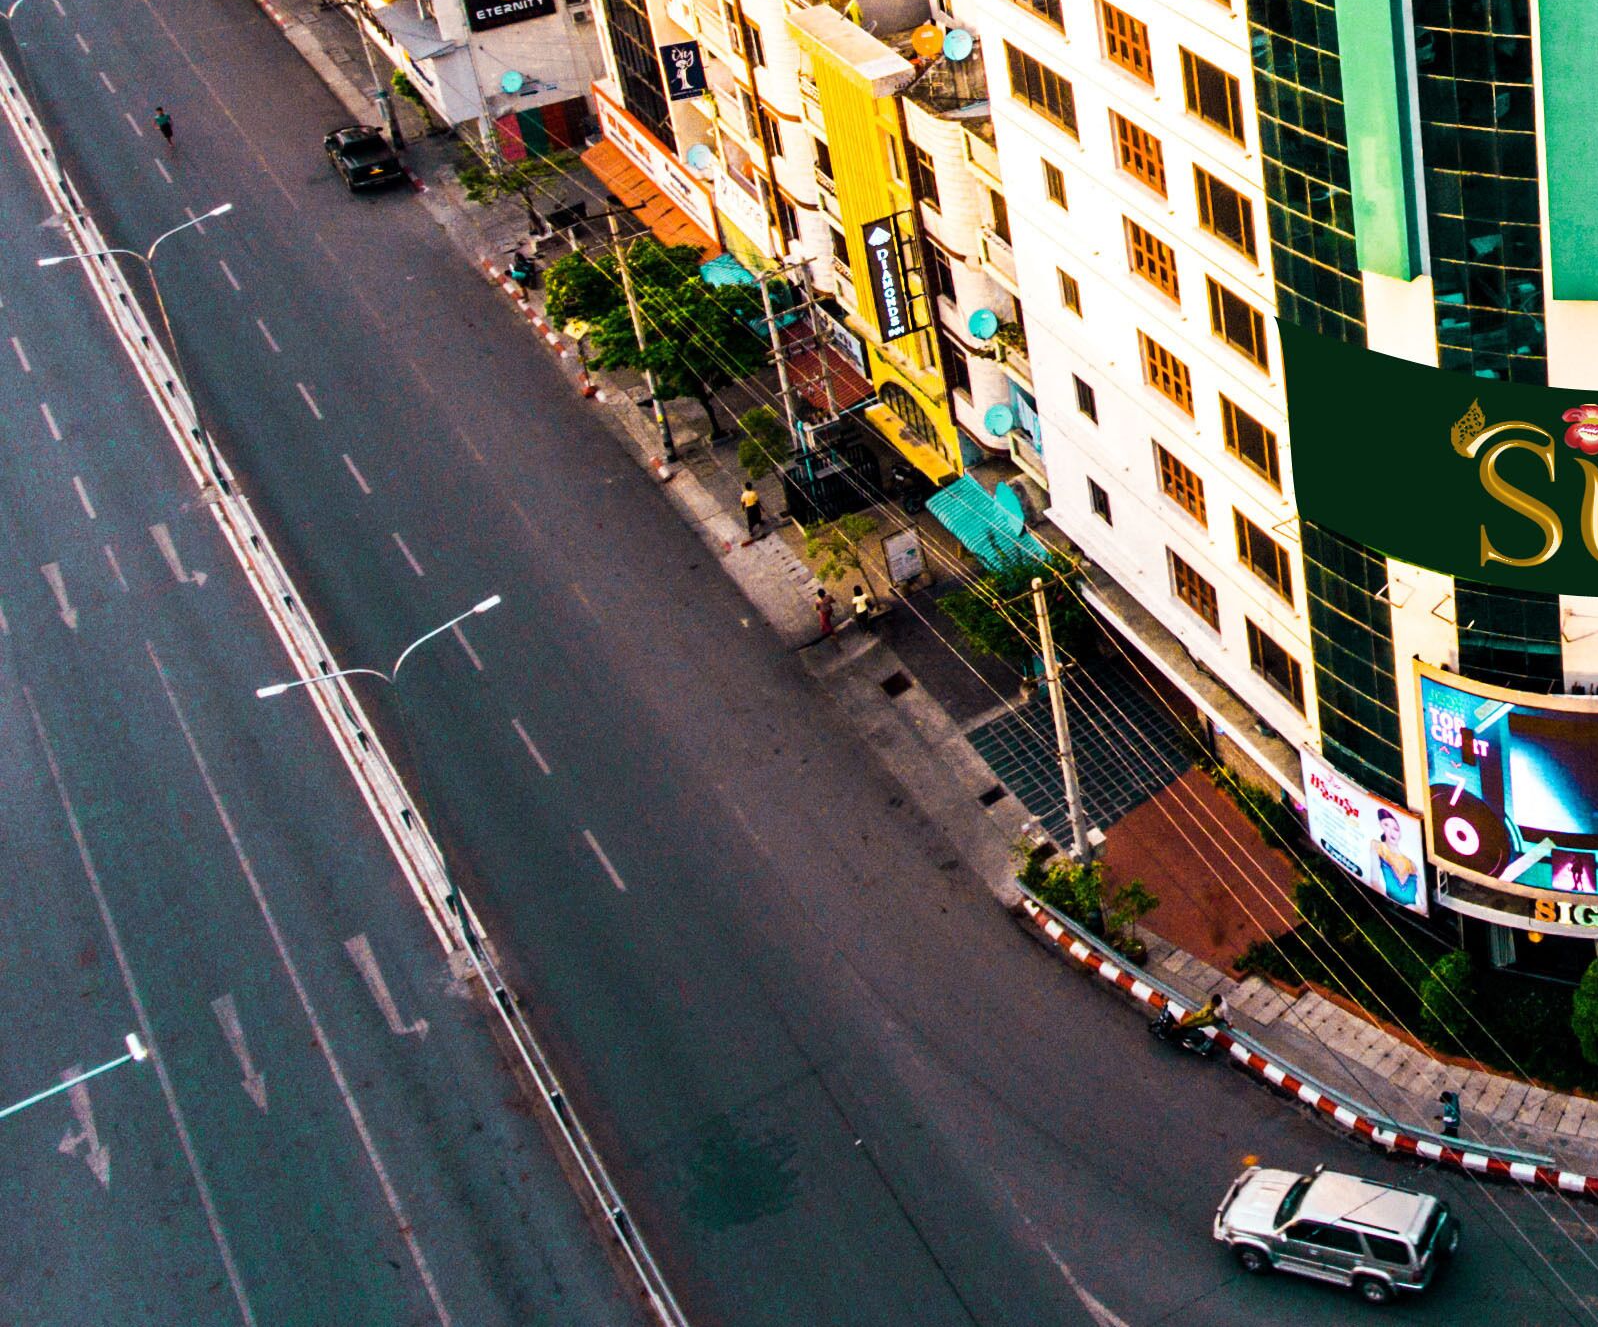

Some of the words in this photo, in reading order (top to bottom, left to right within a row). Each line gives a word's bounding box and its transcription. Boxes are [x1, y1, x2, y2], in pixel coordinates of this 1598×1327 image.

[875, 248, 900, 327] DIAMONDS
[1429, 707, 1466, 734] TOP
[1445, 772, 1466, 807] 7
